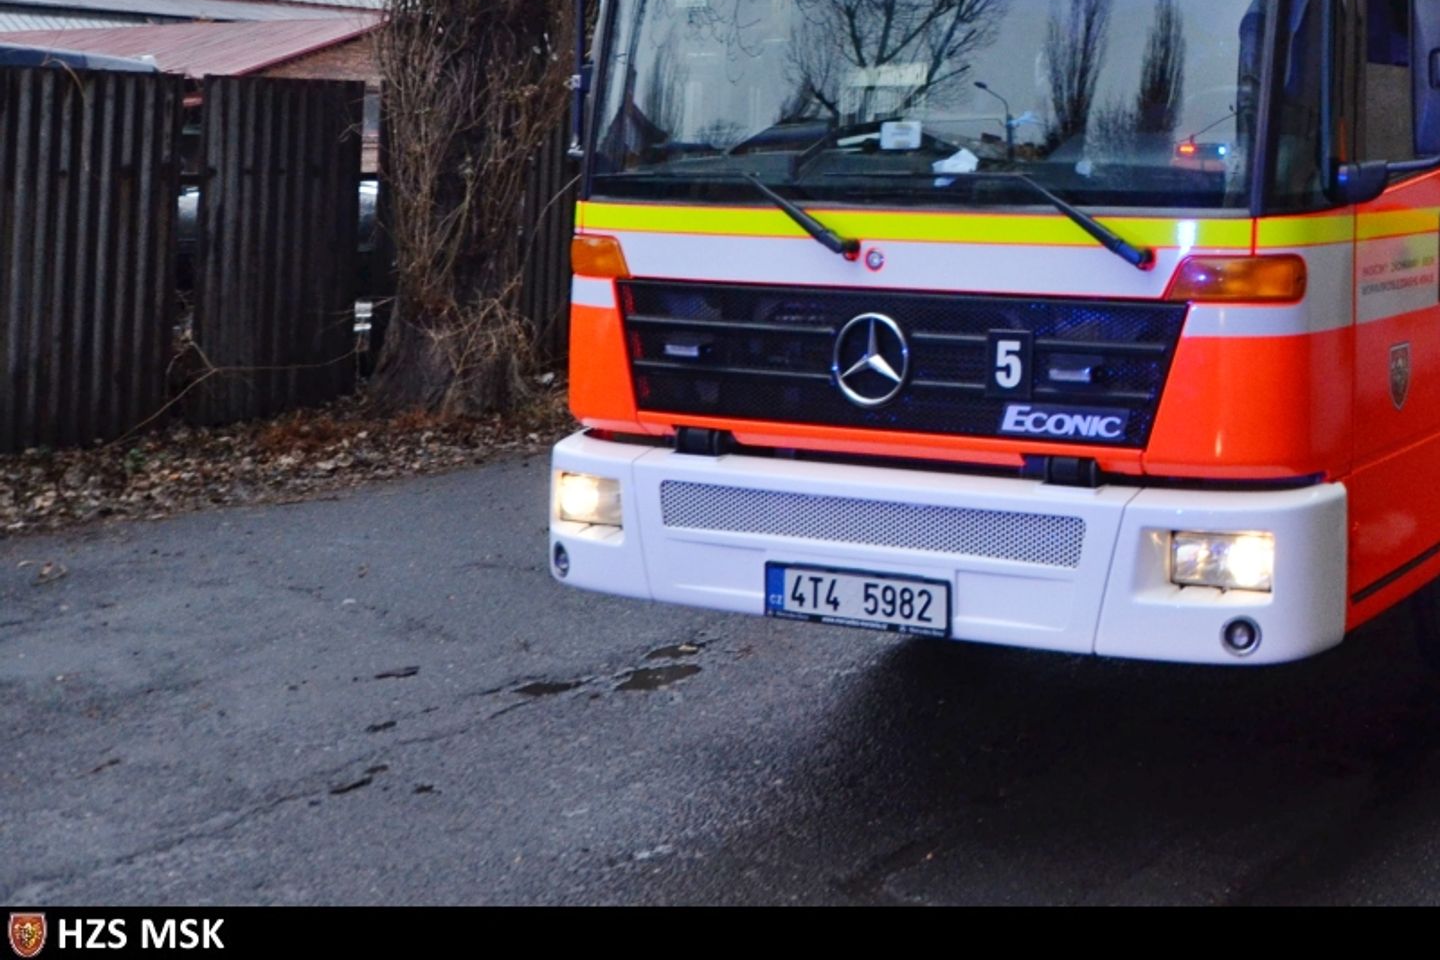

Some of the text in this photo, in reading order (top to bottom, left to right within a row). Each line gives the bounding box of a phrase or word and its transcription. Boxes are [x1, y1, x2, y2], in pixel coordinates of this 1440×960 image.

[995, 339, 1022, 389] 5
[1001, 404, 1122, 438] ECONIC
[790, 574, 933, 623] 4T4 5982
